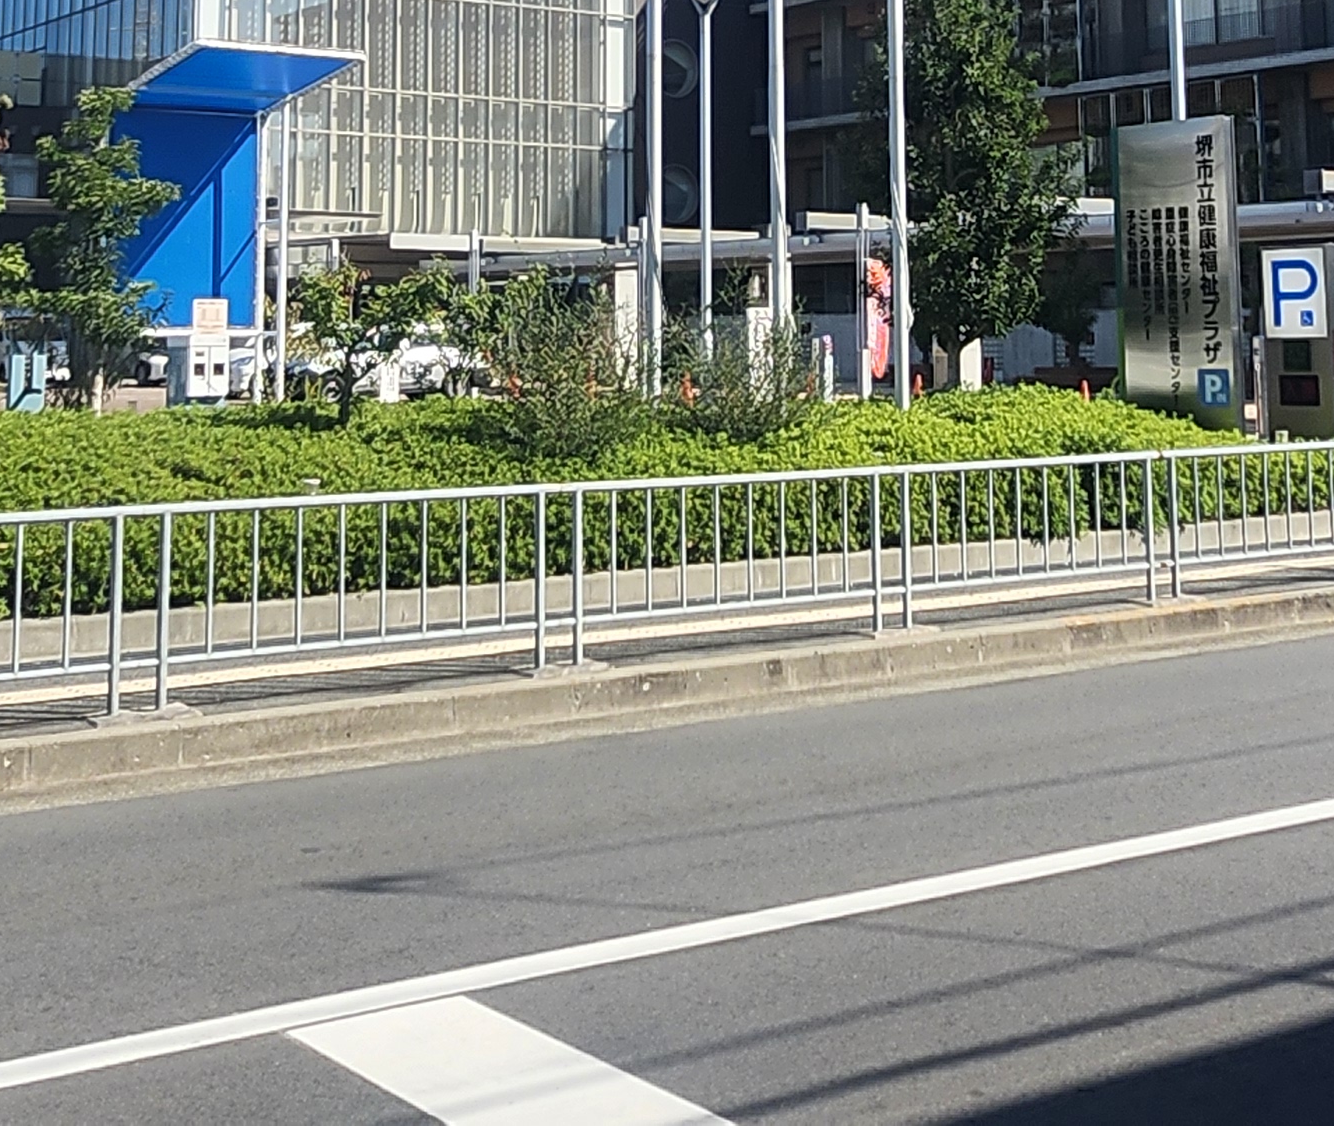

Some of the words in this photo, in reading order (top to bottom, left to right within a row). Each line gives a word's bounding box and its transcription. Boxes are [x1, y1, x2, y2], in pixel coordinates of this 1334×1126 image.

[1194, 134, 1222, 364] 堺市立健康福祉プラザ
[1270, 259, 1318, 328] P
[1204, 374, 1223, 404] P
